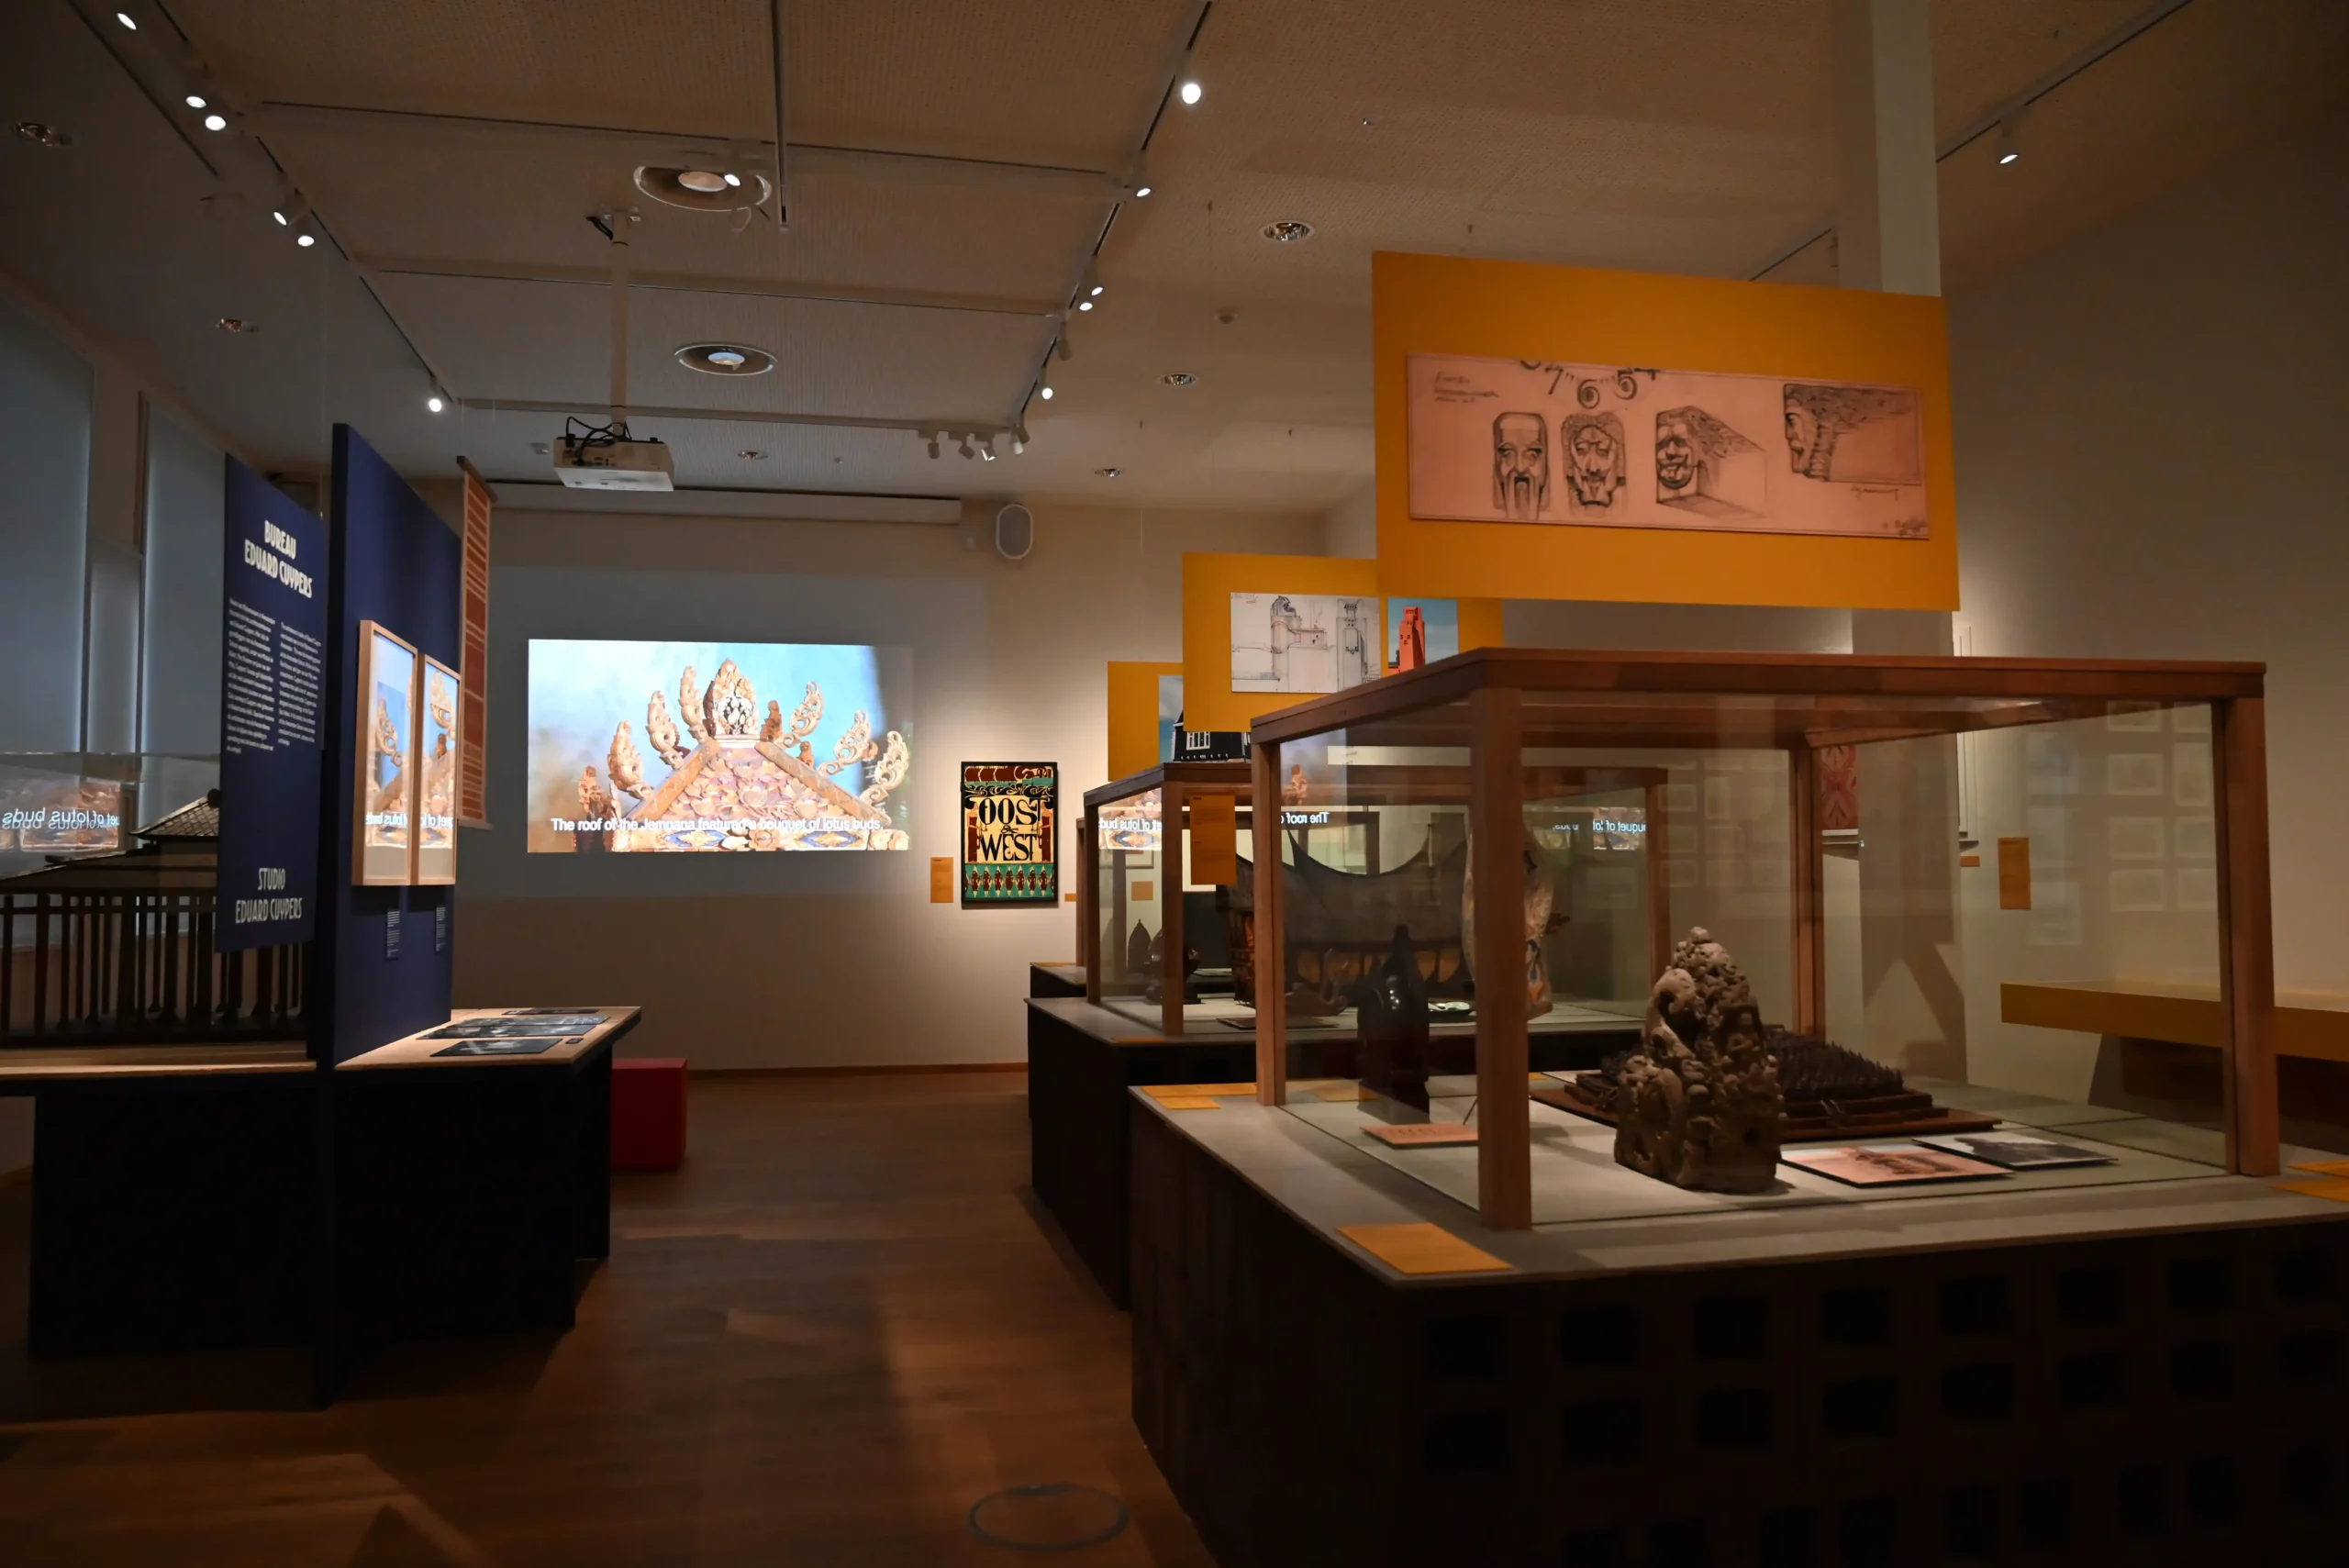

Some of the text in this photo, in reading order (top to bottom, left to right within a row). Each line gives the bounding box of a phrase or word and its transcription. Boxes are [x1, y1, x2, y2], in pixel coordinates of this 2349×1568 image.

[1576, 379, 1601, 409] 6
[264, 519, 296, 560] BUREAU
[244, 539, 313, 598] EDUARD CUYPERS
[551, 817, 576, 832] The
[577, 817, 604, 832] roof
[605, 817, 618, 832] of
[619, 817, 639, 831] the
[697, 818, 747, 832] featured
[749, 820, 757, 830] a
[760, 818, 807, 834] bouquet
[808, 818, 822, 831] of
[822, 818, 851, 831] lotus
[852, 818, 884, 831] buds.
[978, 797, 1046, 826] OOST
[1001, 825, 1019, 834] &
[980, 833, 1038, 862] WEST
[258, 867, 286, 891] STUDIO
[235, 896, 303, 924] EDUARD CUYPERS
